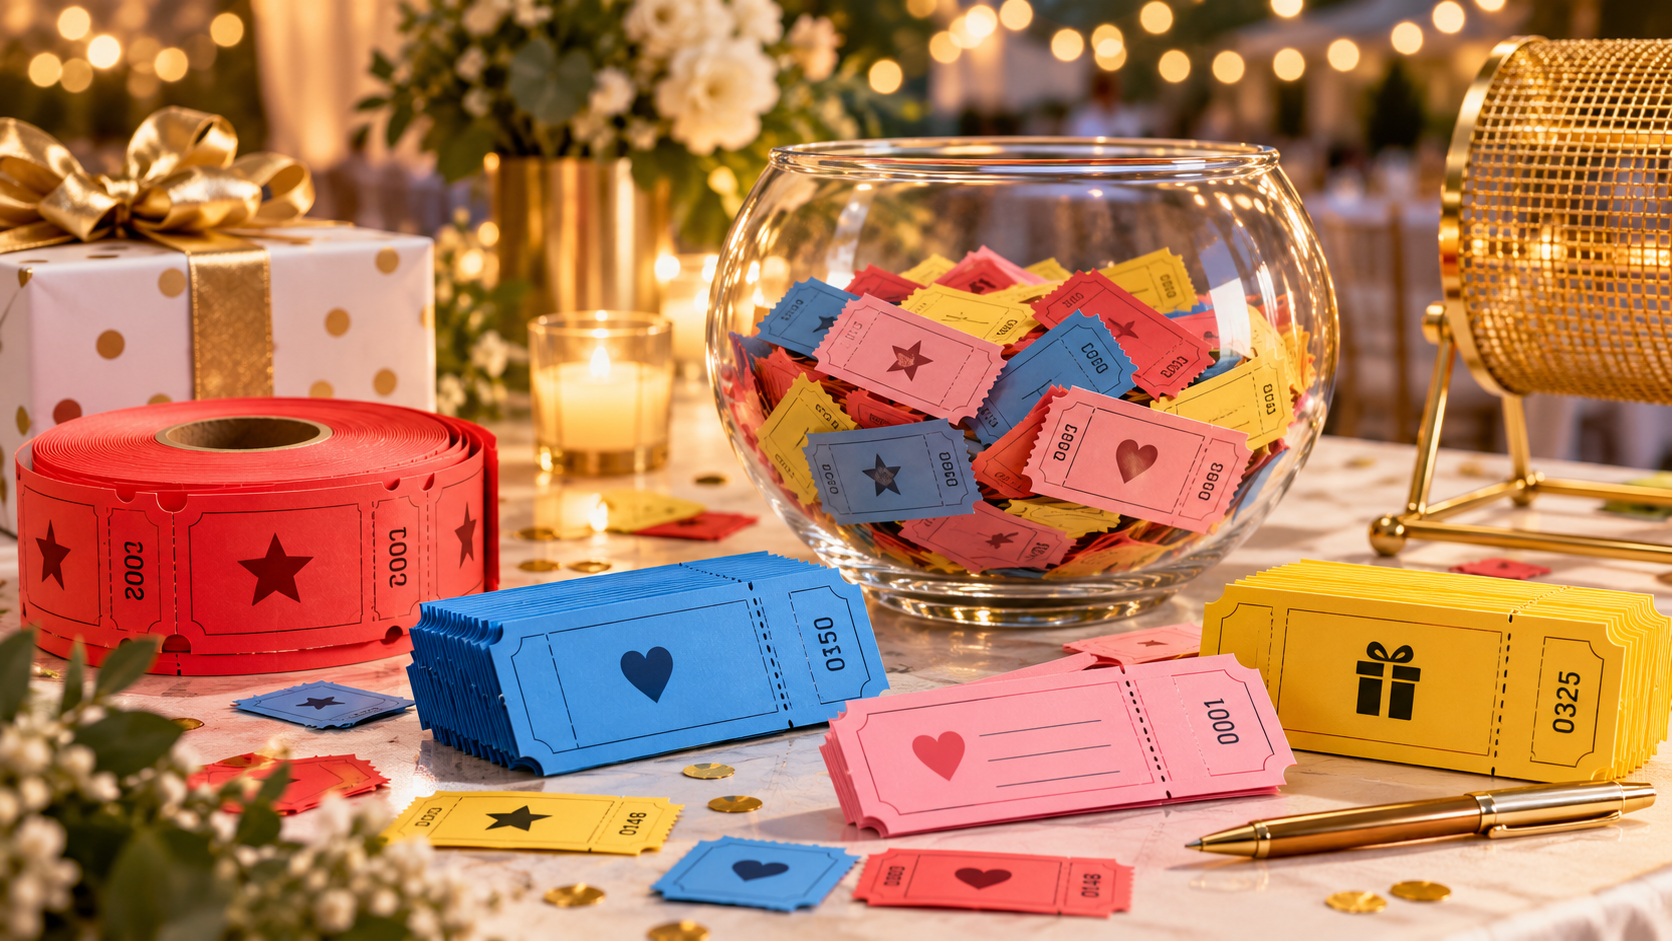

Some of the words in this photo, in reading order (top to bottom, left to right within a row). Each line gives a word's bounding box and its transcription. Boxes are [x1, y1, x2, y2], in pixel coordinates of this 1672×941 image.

[1203, 698, 1240, 745] 0001
[1552, 671, 1581, 734] 0325
[619, 812, 646, 836] 0148
